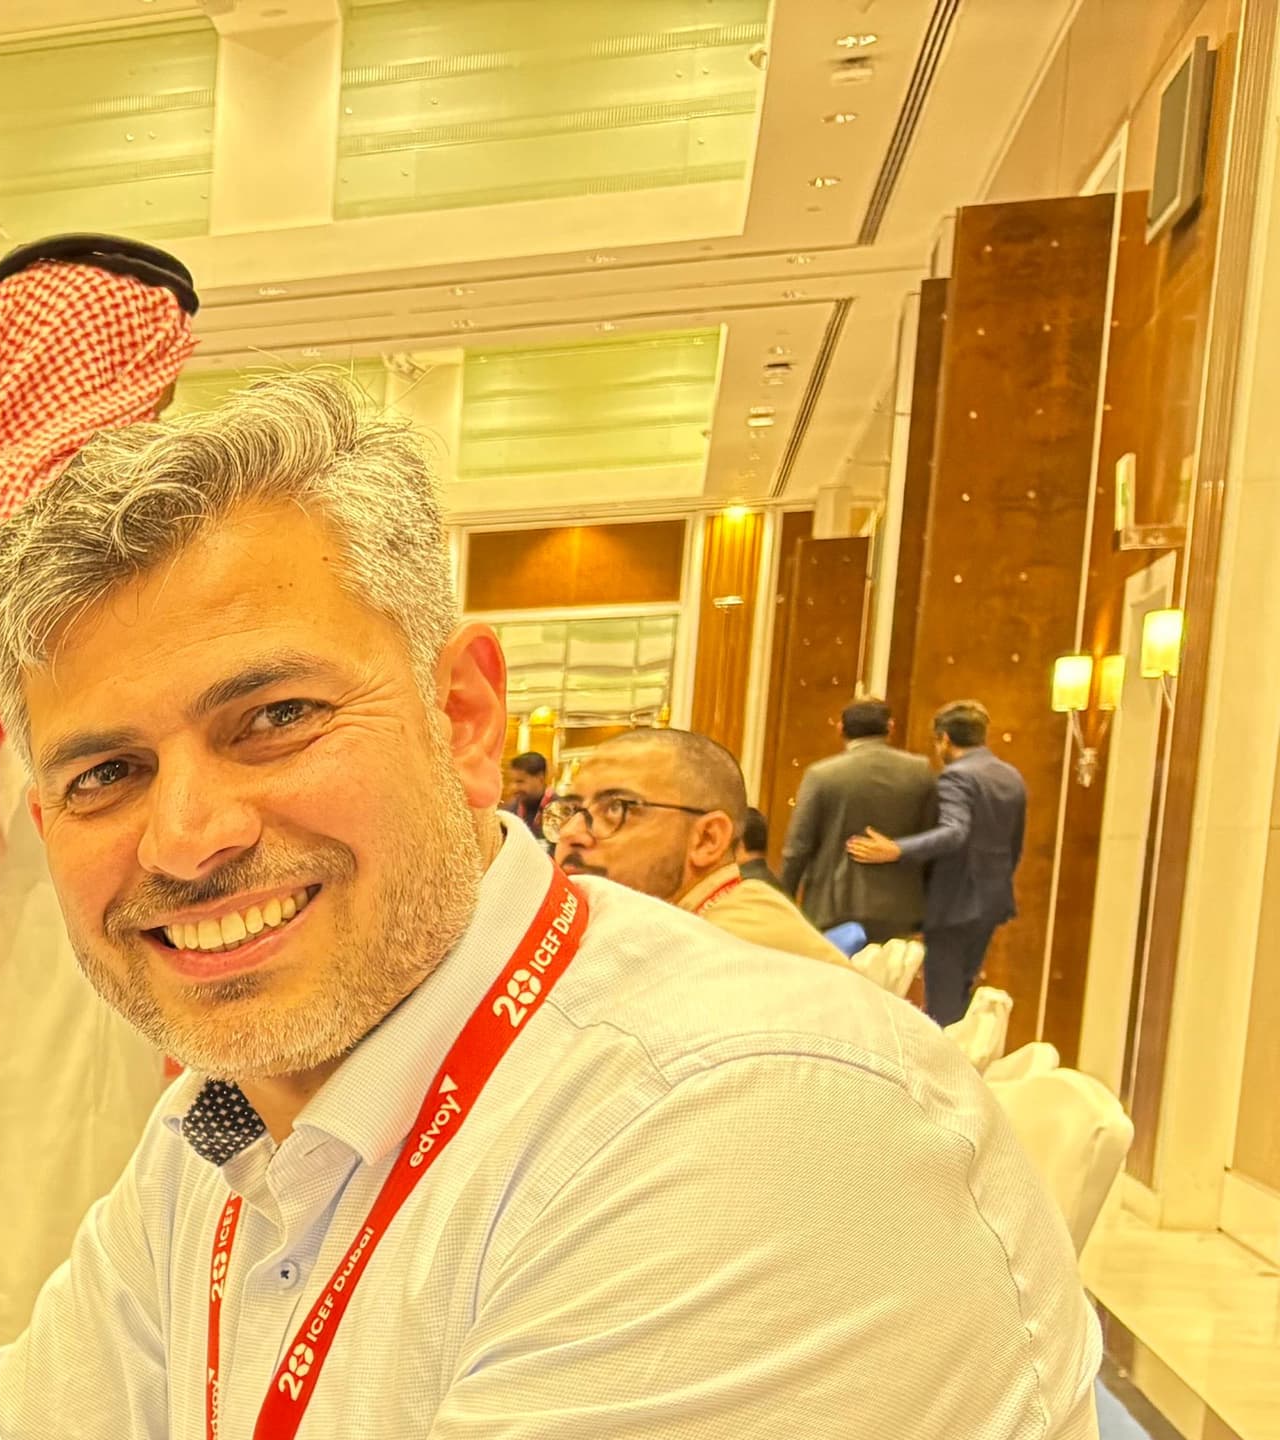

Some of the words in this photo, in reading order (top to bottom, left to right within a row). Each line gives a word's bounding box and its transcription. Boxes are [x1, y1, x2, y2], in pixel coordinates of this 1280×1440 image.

[529, 929, 561, 974] ICEF
[409, 1095, 463, 1168] edvoy
[306, 1293, 336, 1342] ICEF
[333, 1226, 375, 1293] Dubai
